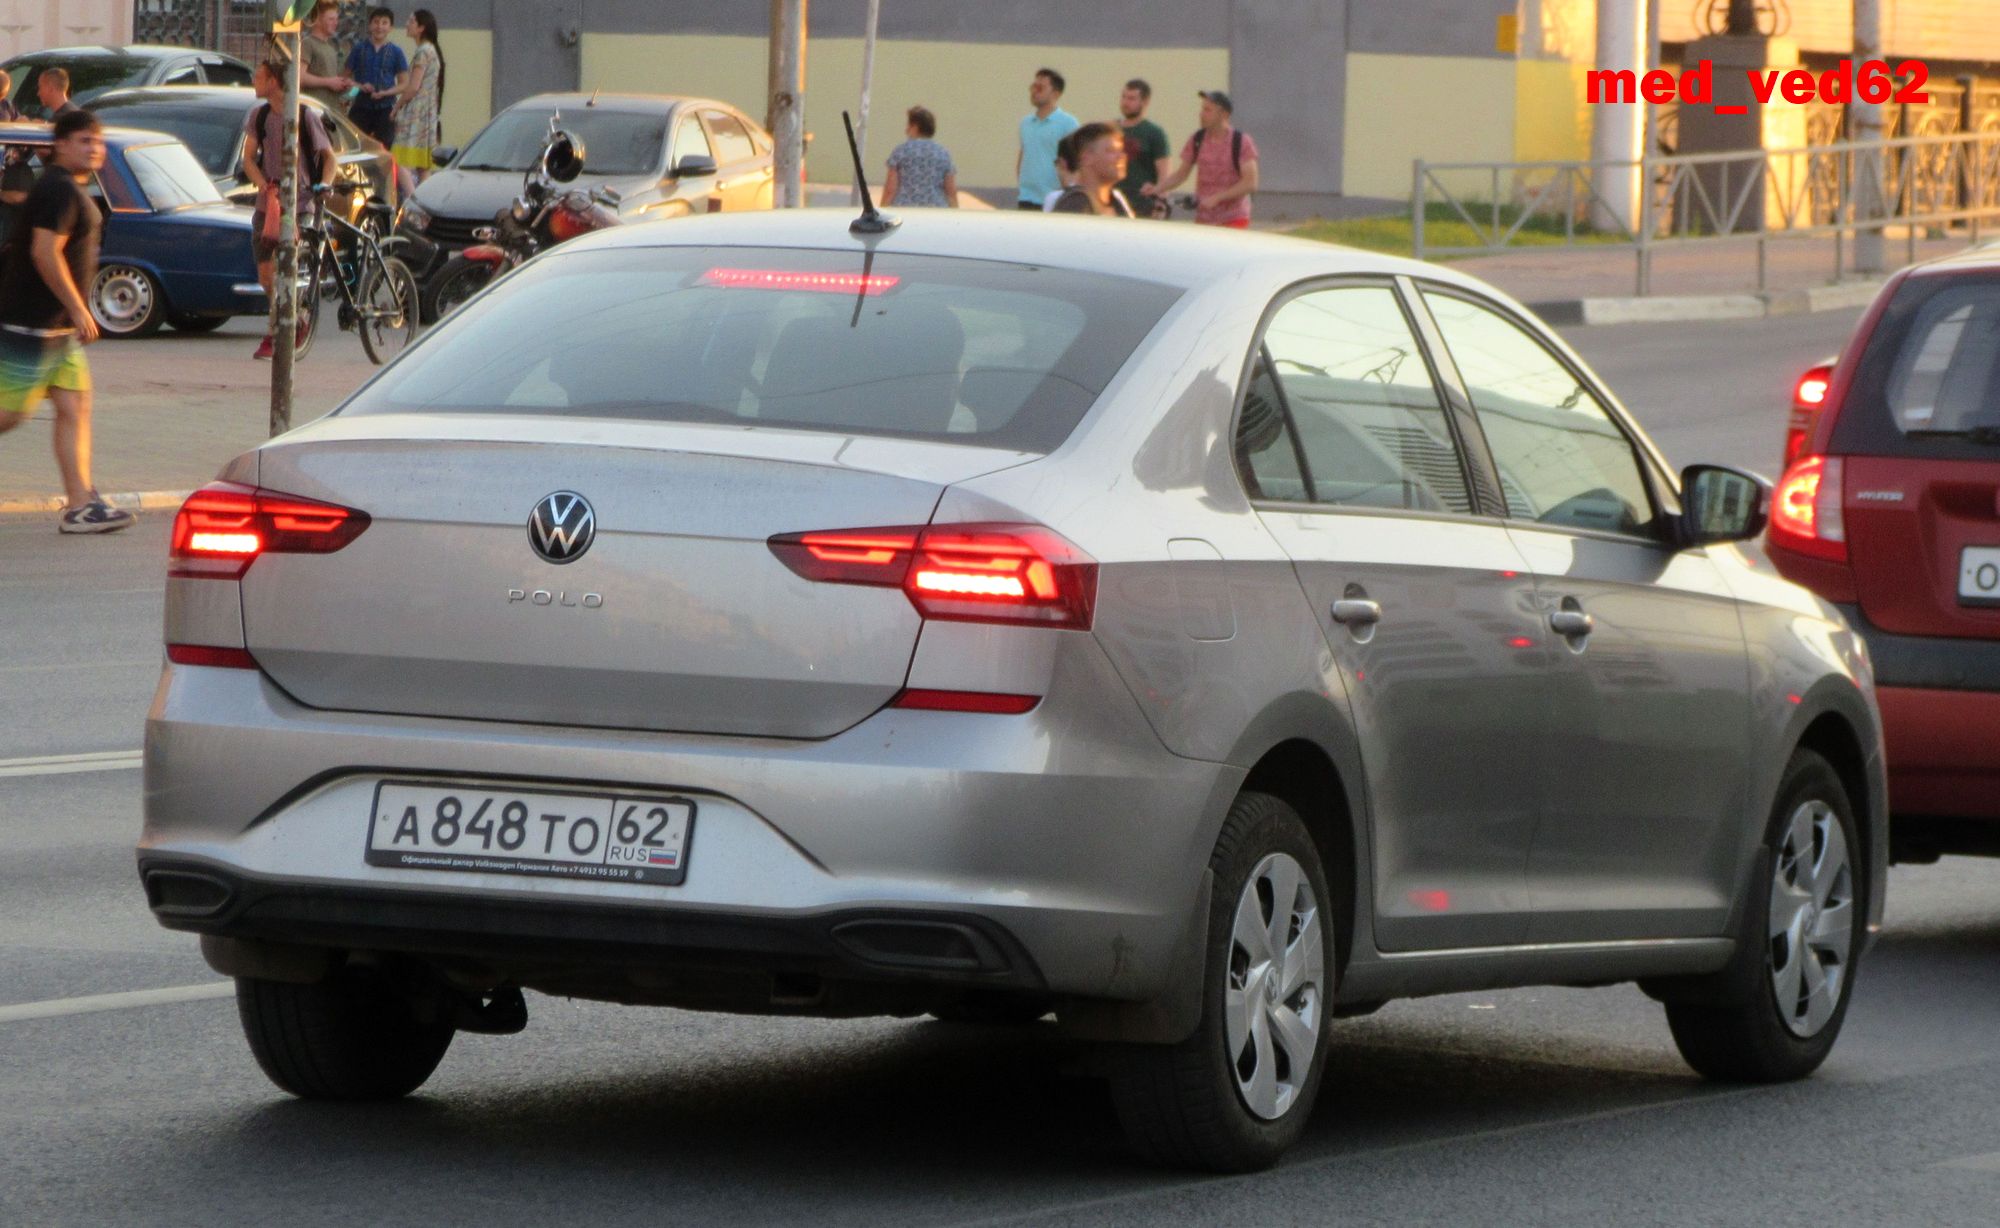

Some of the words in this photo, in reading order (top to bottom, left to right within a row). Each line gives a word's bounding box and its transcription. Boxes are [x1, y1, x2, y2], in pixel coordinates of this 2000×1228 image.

[508, 589, 603, 608] POLO
[616, 806, 670, 847] 62
[609, 845, 648, 862] RUS
